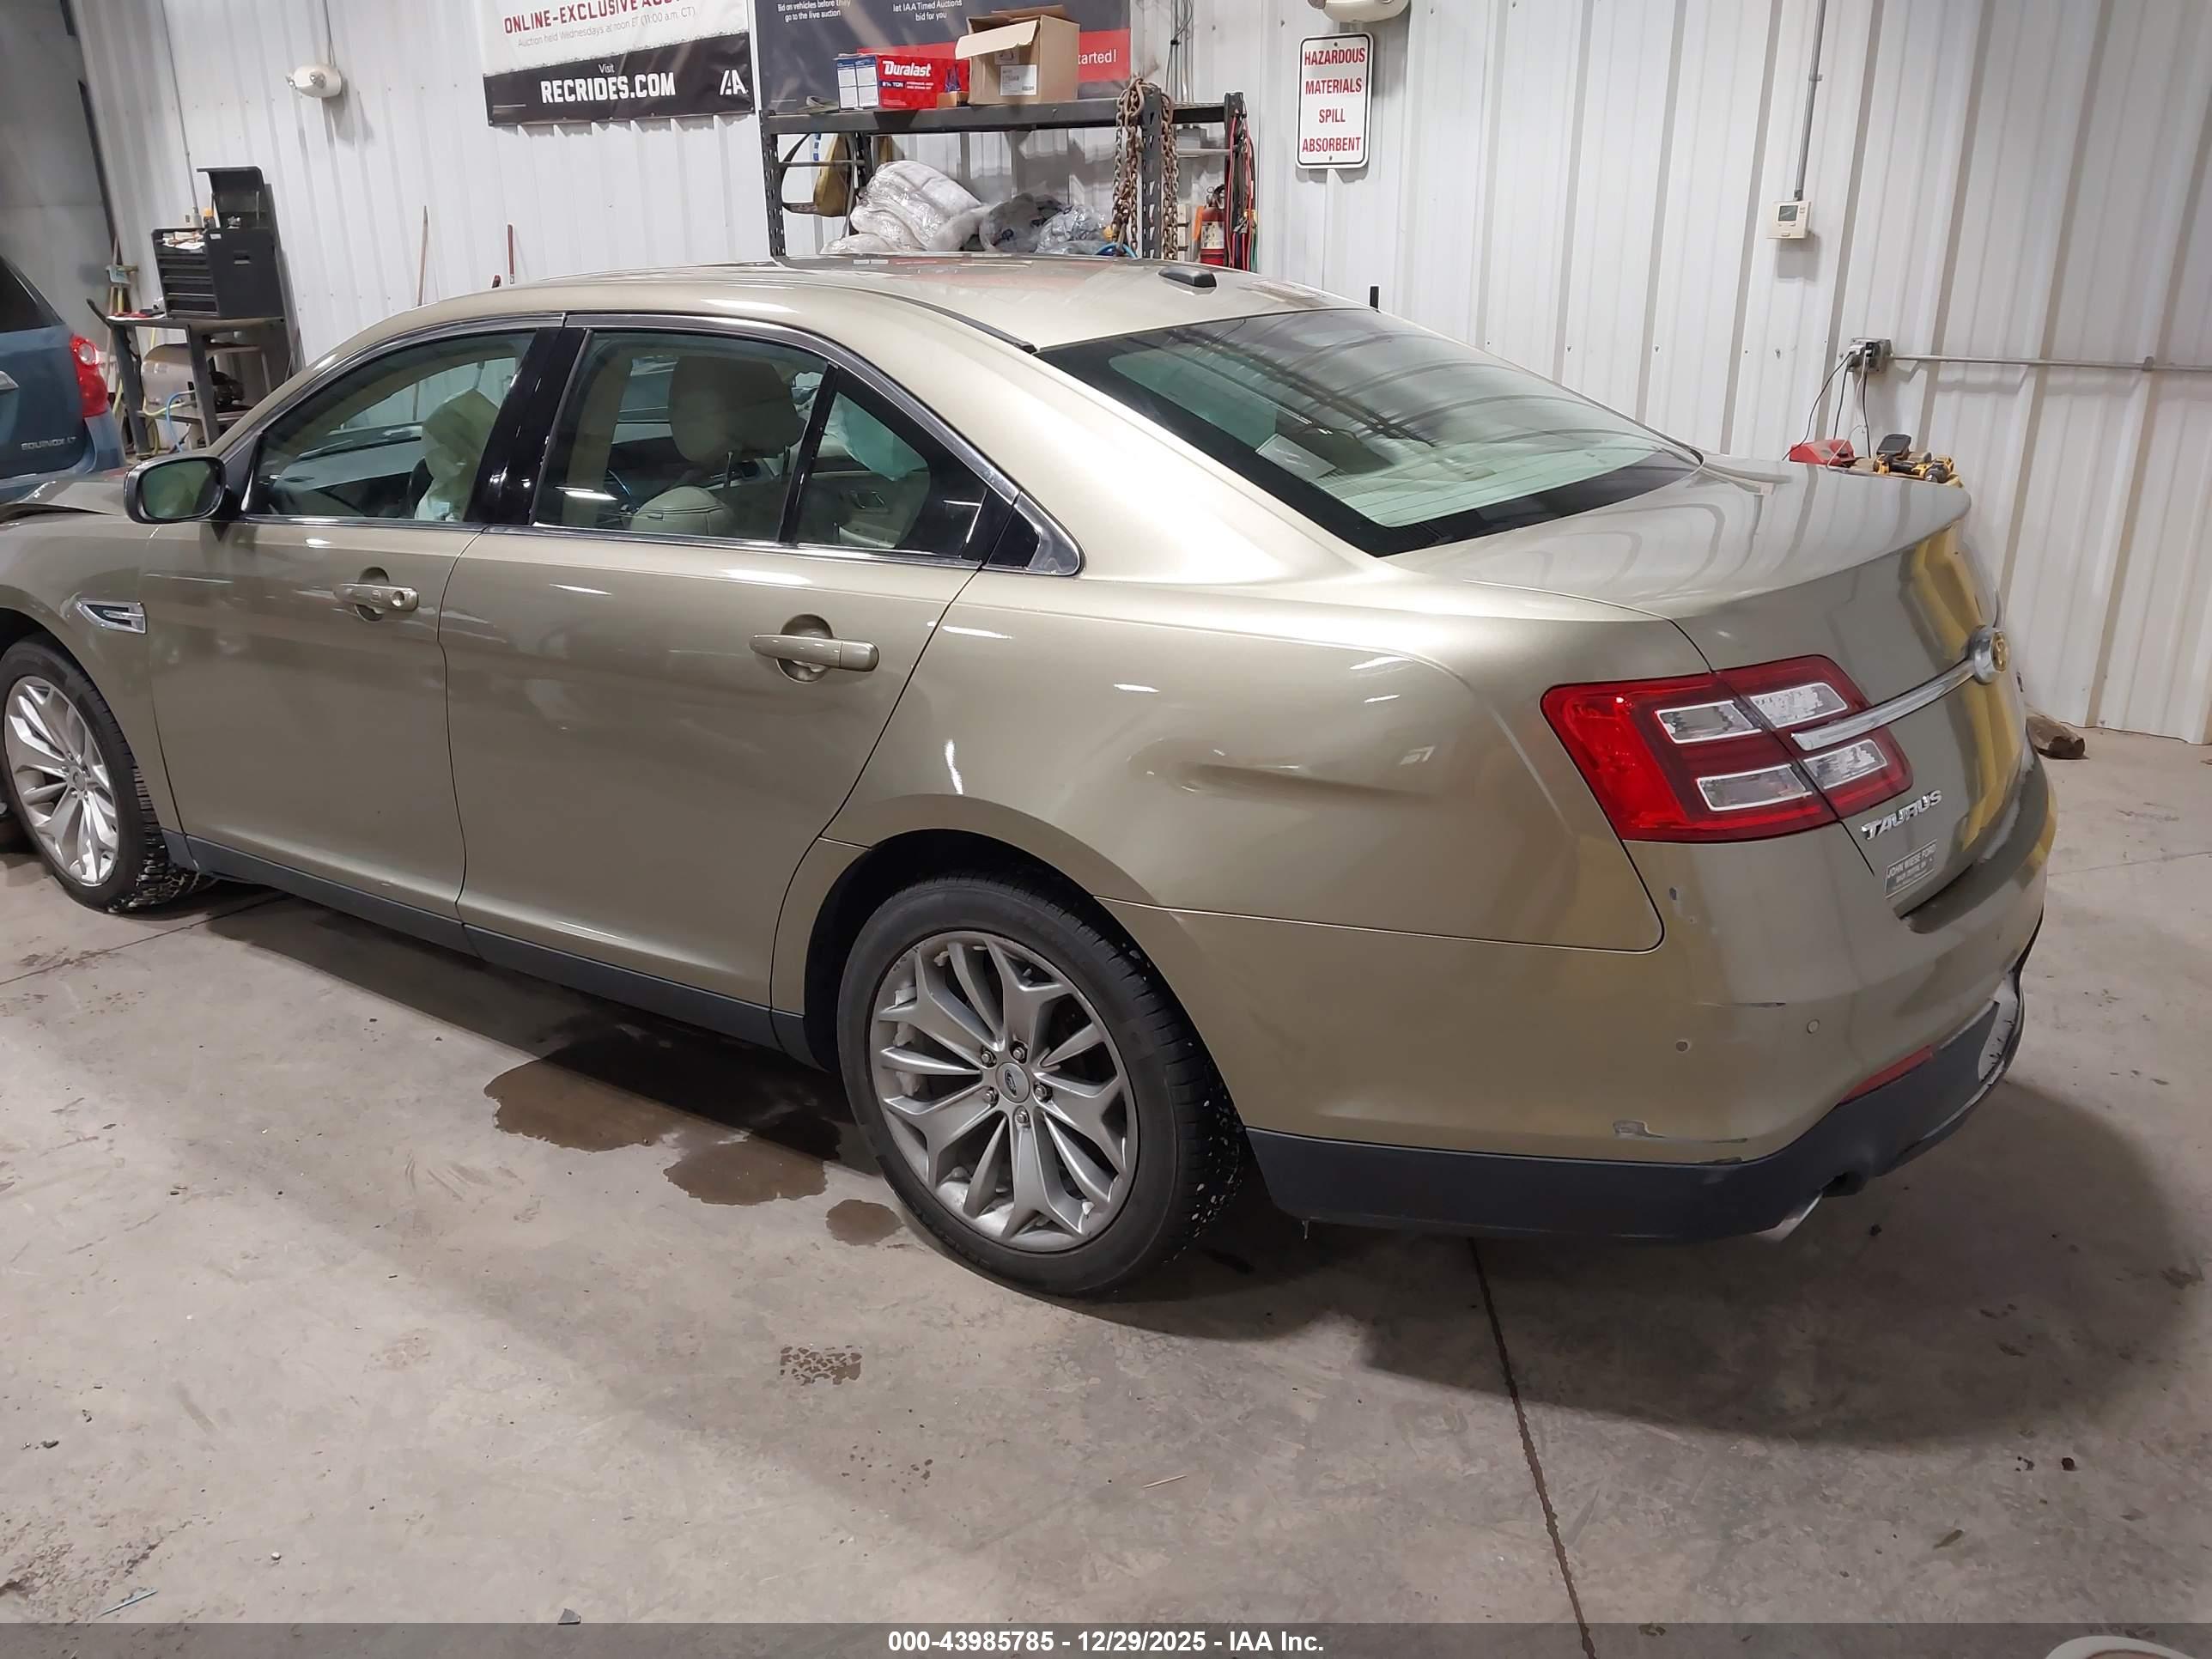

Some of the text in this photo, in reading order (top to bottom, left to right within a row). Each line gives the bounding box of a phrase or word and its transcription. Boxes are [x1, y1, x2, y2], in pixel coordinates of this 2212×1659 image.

[793, 1, 817, 10] vehicles
[821, 9, 841, 18] auction
[893, 0, 963, 12] let IAA Timed Auctions
[505, 0, 638, 33] ONLINE-EXCLUSIVE
[936, 12, 947, 21] you
[518, 36, 544, 47] Auction
[561, 26, 604, 40] Wednesdays
[1304, 47, 1365, 66] HAZARDOUS
[599, 63, 615, 74] Visit
[882, 60, 932, 76] Duralast
[540, 72, 676, 104] RECRIDES.COM
[1305, 77, 1362, 95] MATERIALS
[1318, 108, 1346, 124] SPILL
[1302, 137, 1361, 153] ABSORBENT
[21, 438, 65, 451] EQUINOX
[1862, 789, 1942, 841] TAURUS
